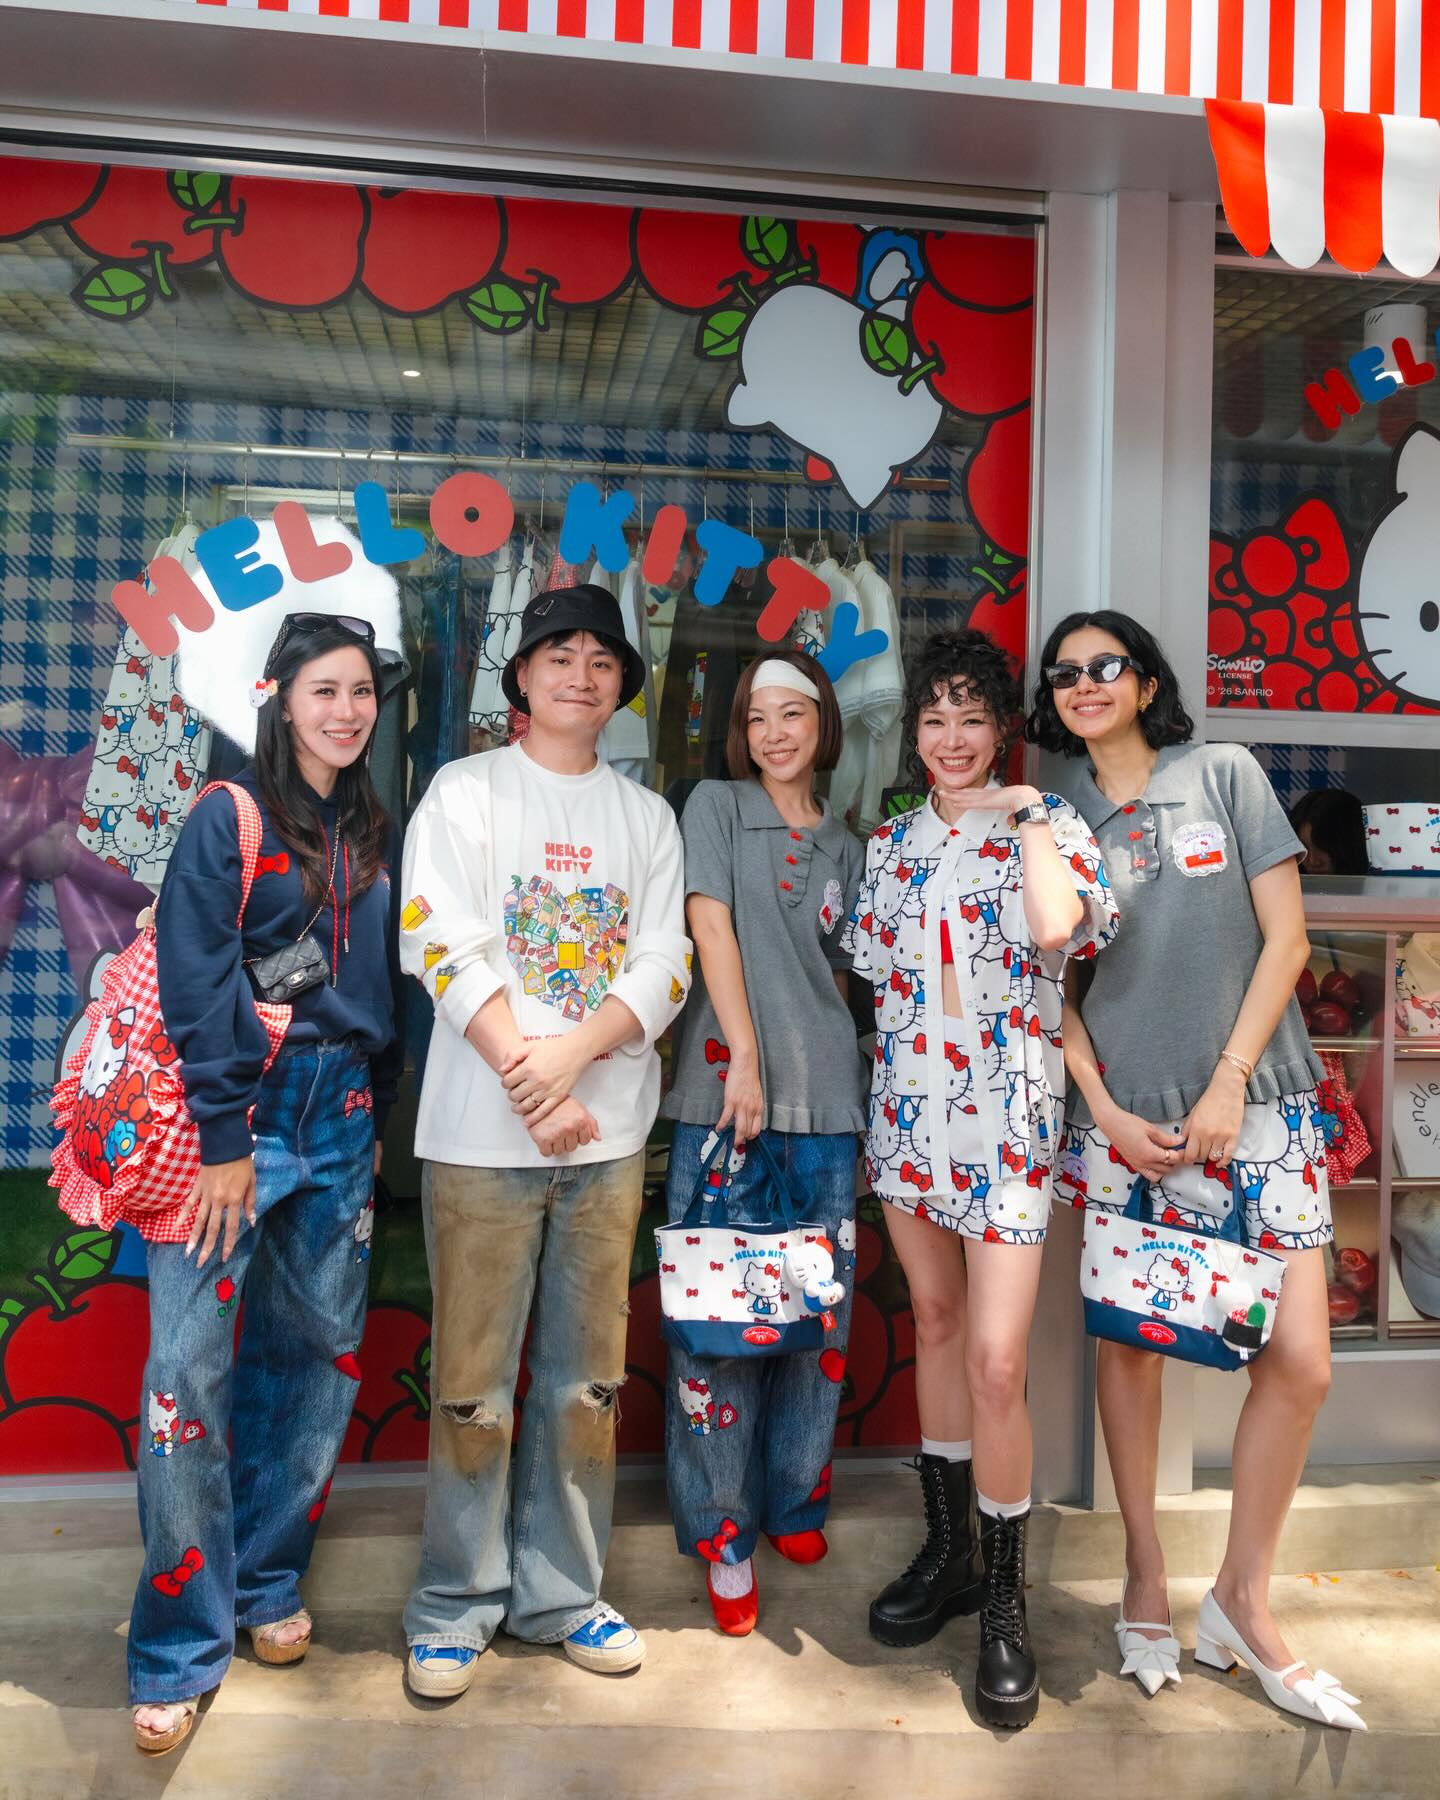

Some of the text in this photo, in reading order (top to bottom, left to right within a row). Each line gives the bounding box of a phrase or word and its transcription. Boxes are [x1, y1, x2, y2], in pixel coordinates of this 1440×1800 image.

[111, 471, 889, 683] HELLO KITTY
[1207, 653, 1265, 673] Sanrio
[1218, 672, 1252, 680] LICENSE
[1234, 687, 1273, 697] SANRIO
[545, 842, 593, 859] HELLO
[735, 1249, 766, 1261] HELLO
[1142, 1241, 1206, 1265] HELLO KITTY
